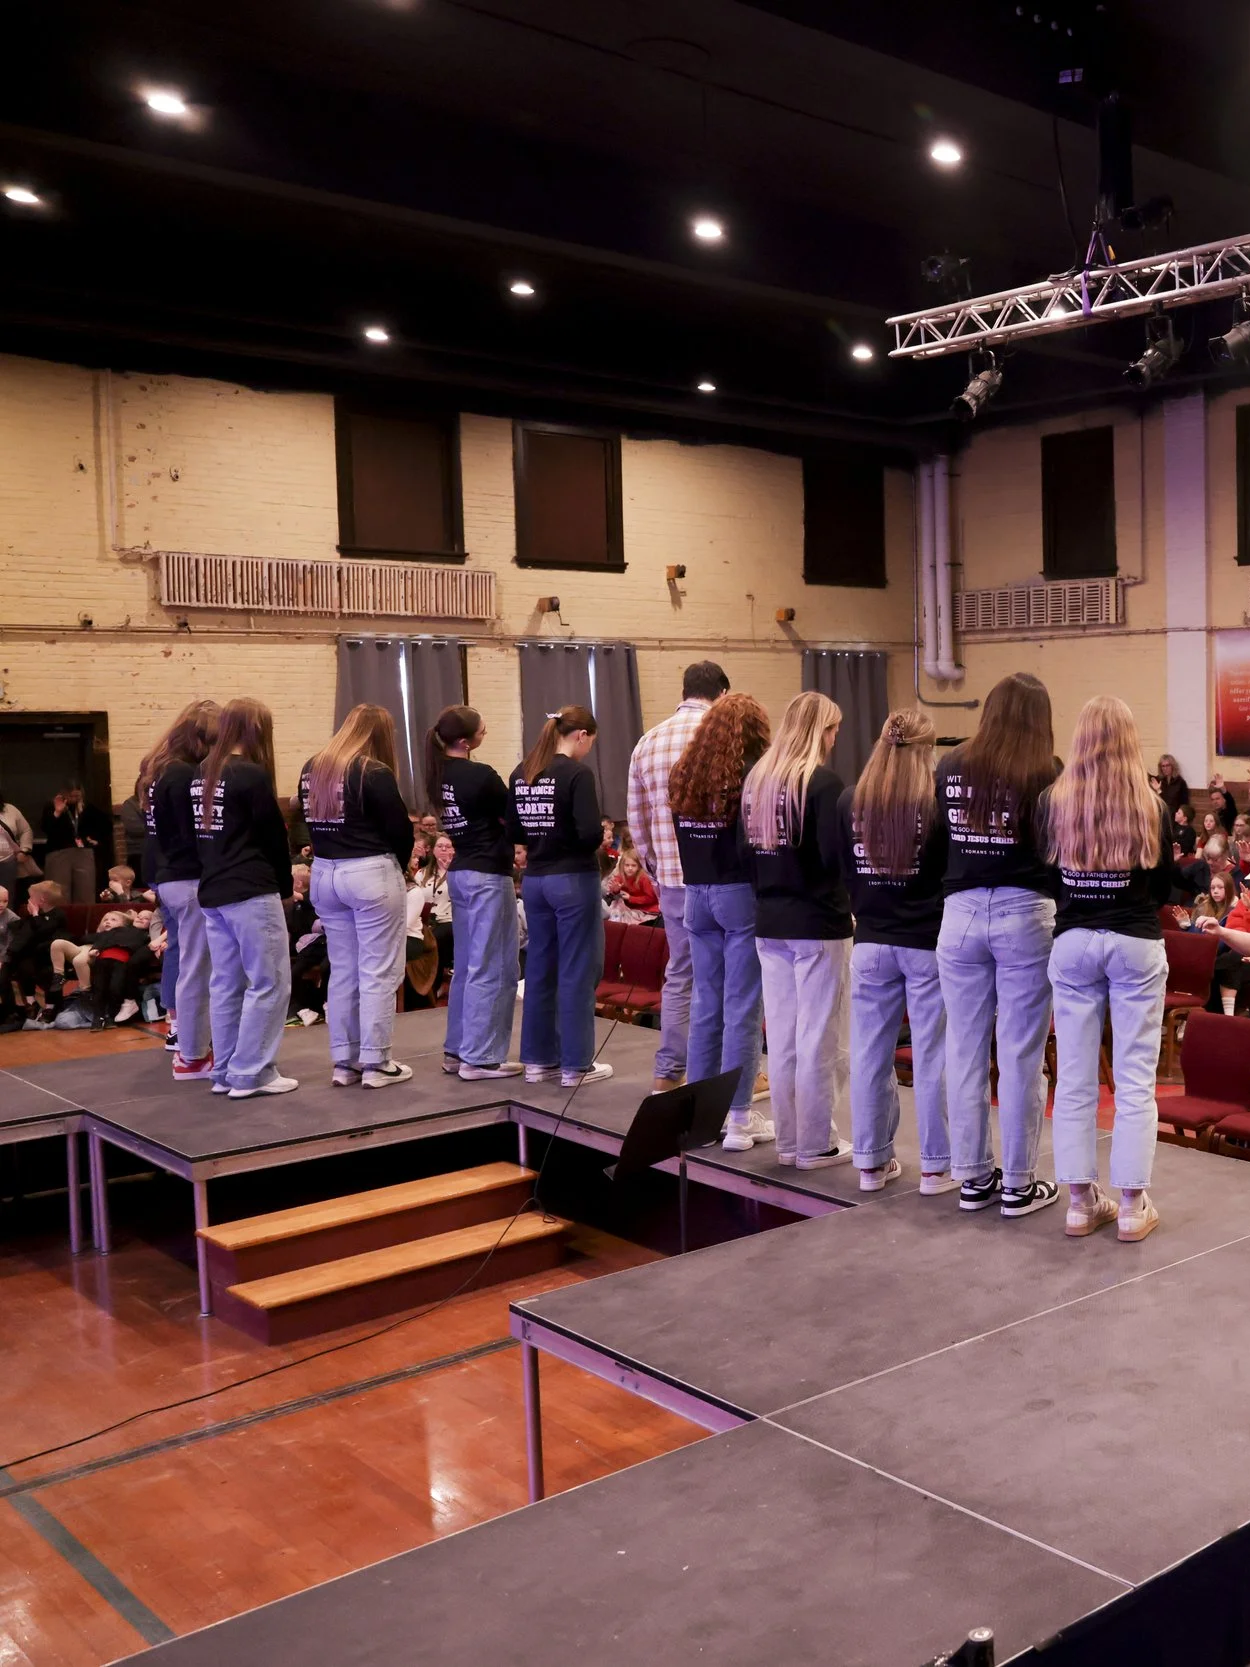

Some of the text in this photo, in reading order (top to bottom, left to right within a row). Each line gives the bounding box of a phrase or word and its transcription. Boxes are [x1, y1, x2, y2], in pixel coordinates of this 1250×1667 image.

[530, 786, 555, 795] VOICE
[516, 803, 554, 814] GLORIFY
[951, 833, 966, 842] LORD
